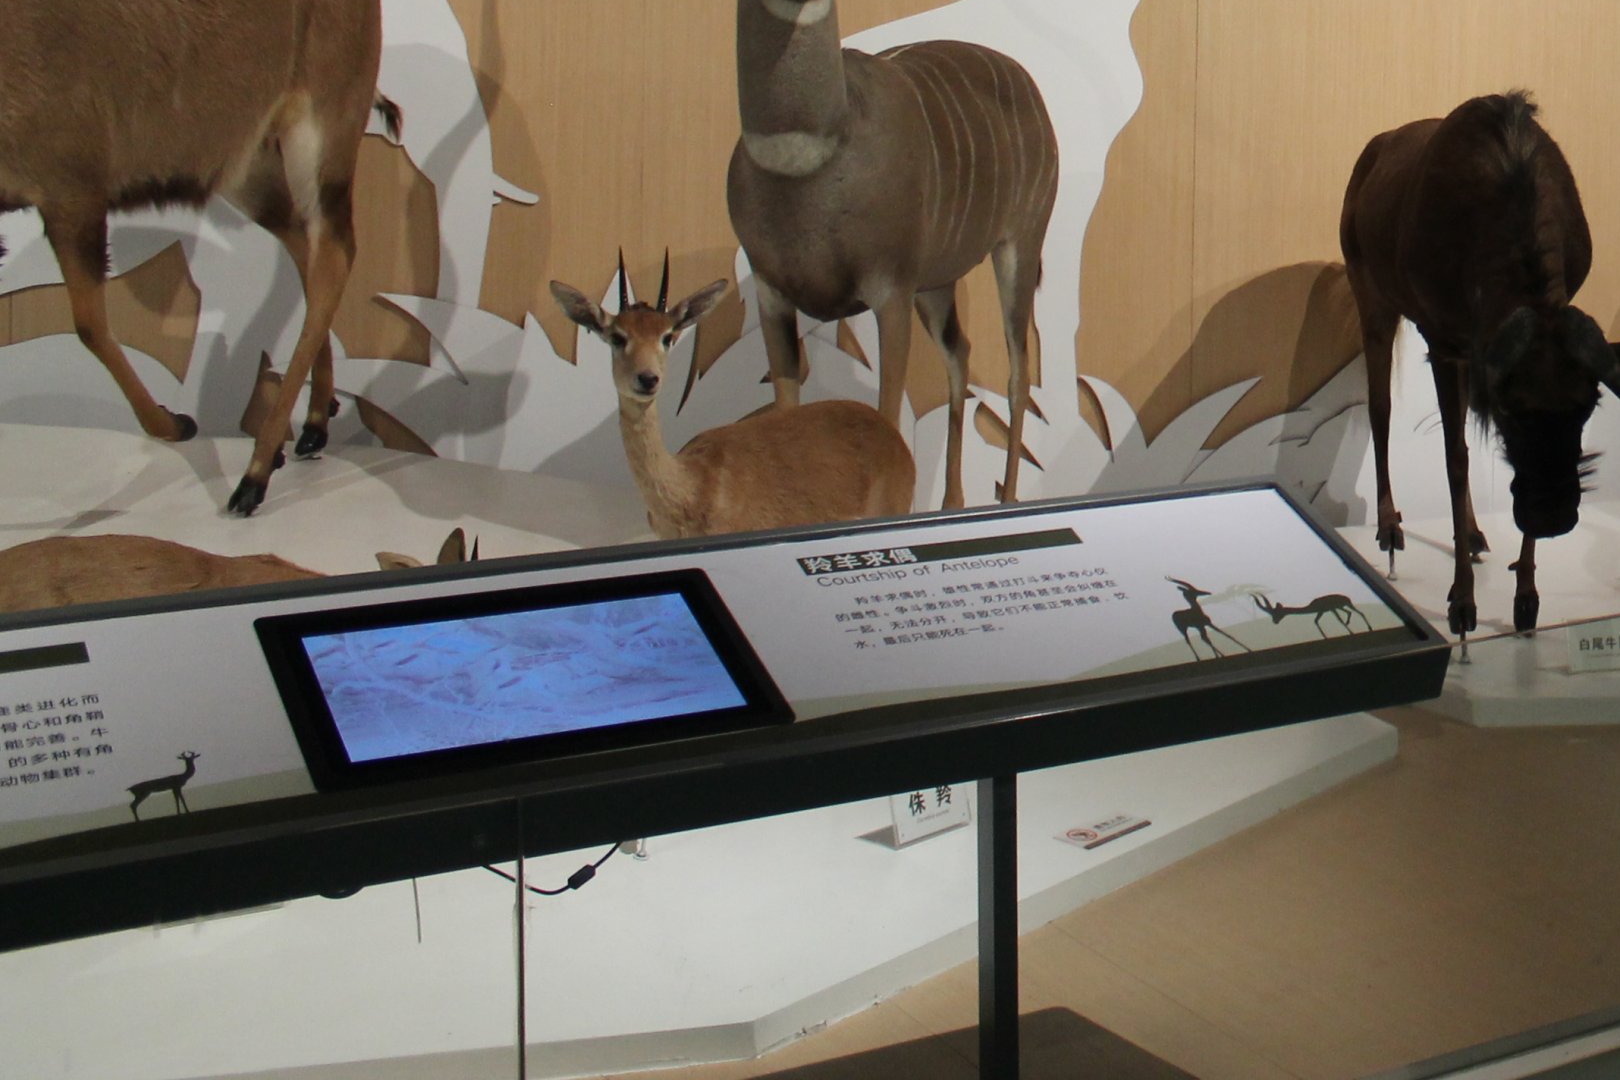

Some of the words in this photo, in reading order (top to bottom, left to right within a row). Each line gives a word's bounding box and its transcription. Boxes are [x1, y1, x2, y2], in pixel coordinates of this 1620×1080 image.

[804, 547, 918, 573] 羚羊求偶
[816, 568, 907, 587] Courtship
[913, 565, 930, 576] of
[941, 555, 1019, 573] Antelope
[909, 784, 952, 816] 侏羚
